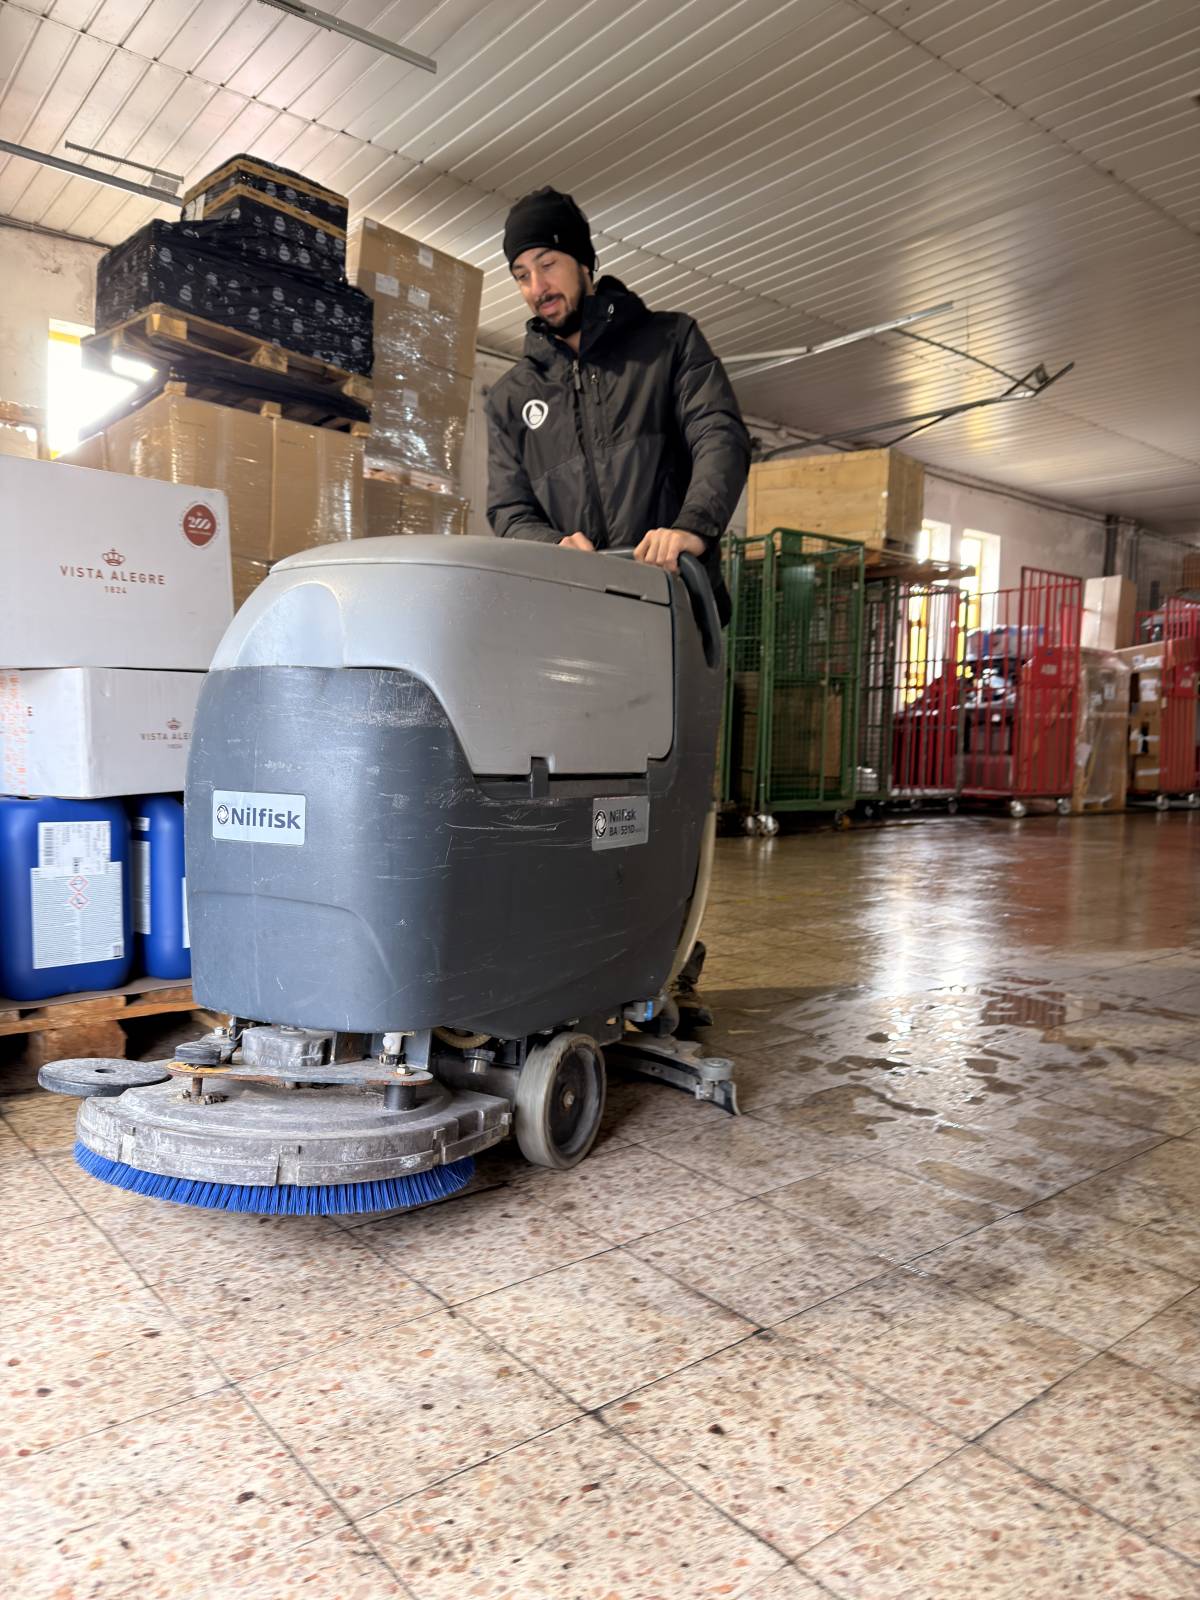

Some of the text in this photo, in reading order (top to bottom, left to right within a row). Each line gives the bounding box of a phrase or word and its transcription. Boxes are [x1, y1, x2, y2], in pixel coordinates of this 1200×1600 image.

[59, 565, 166, 585] VISTA ALEGRE
[104, 585, 127, 594] 1824
[140, 732, 168, 741] VISTA
[231, 807, 301, 830] Nilfisk
[609, 809, 637, 822] Nilfisk
